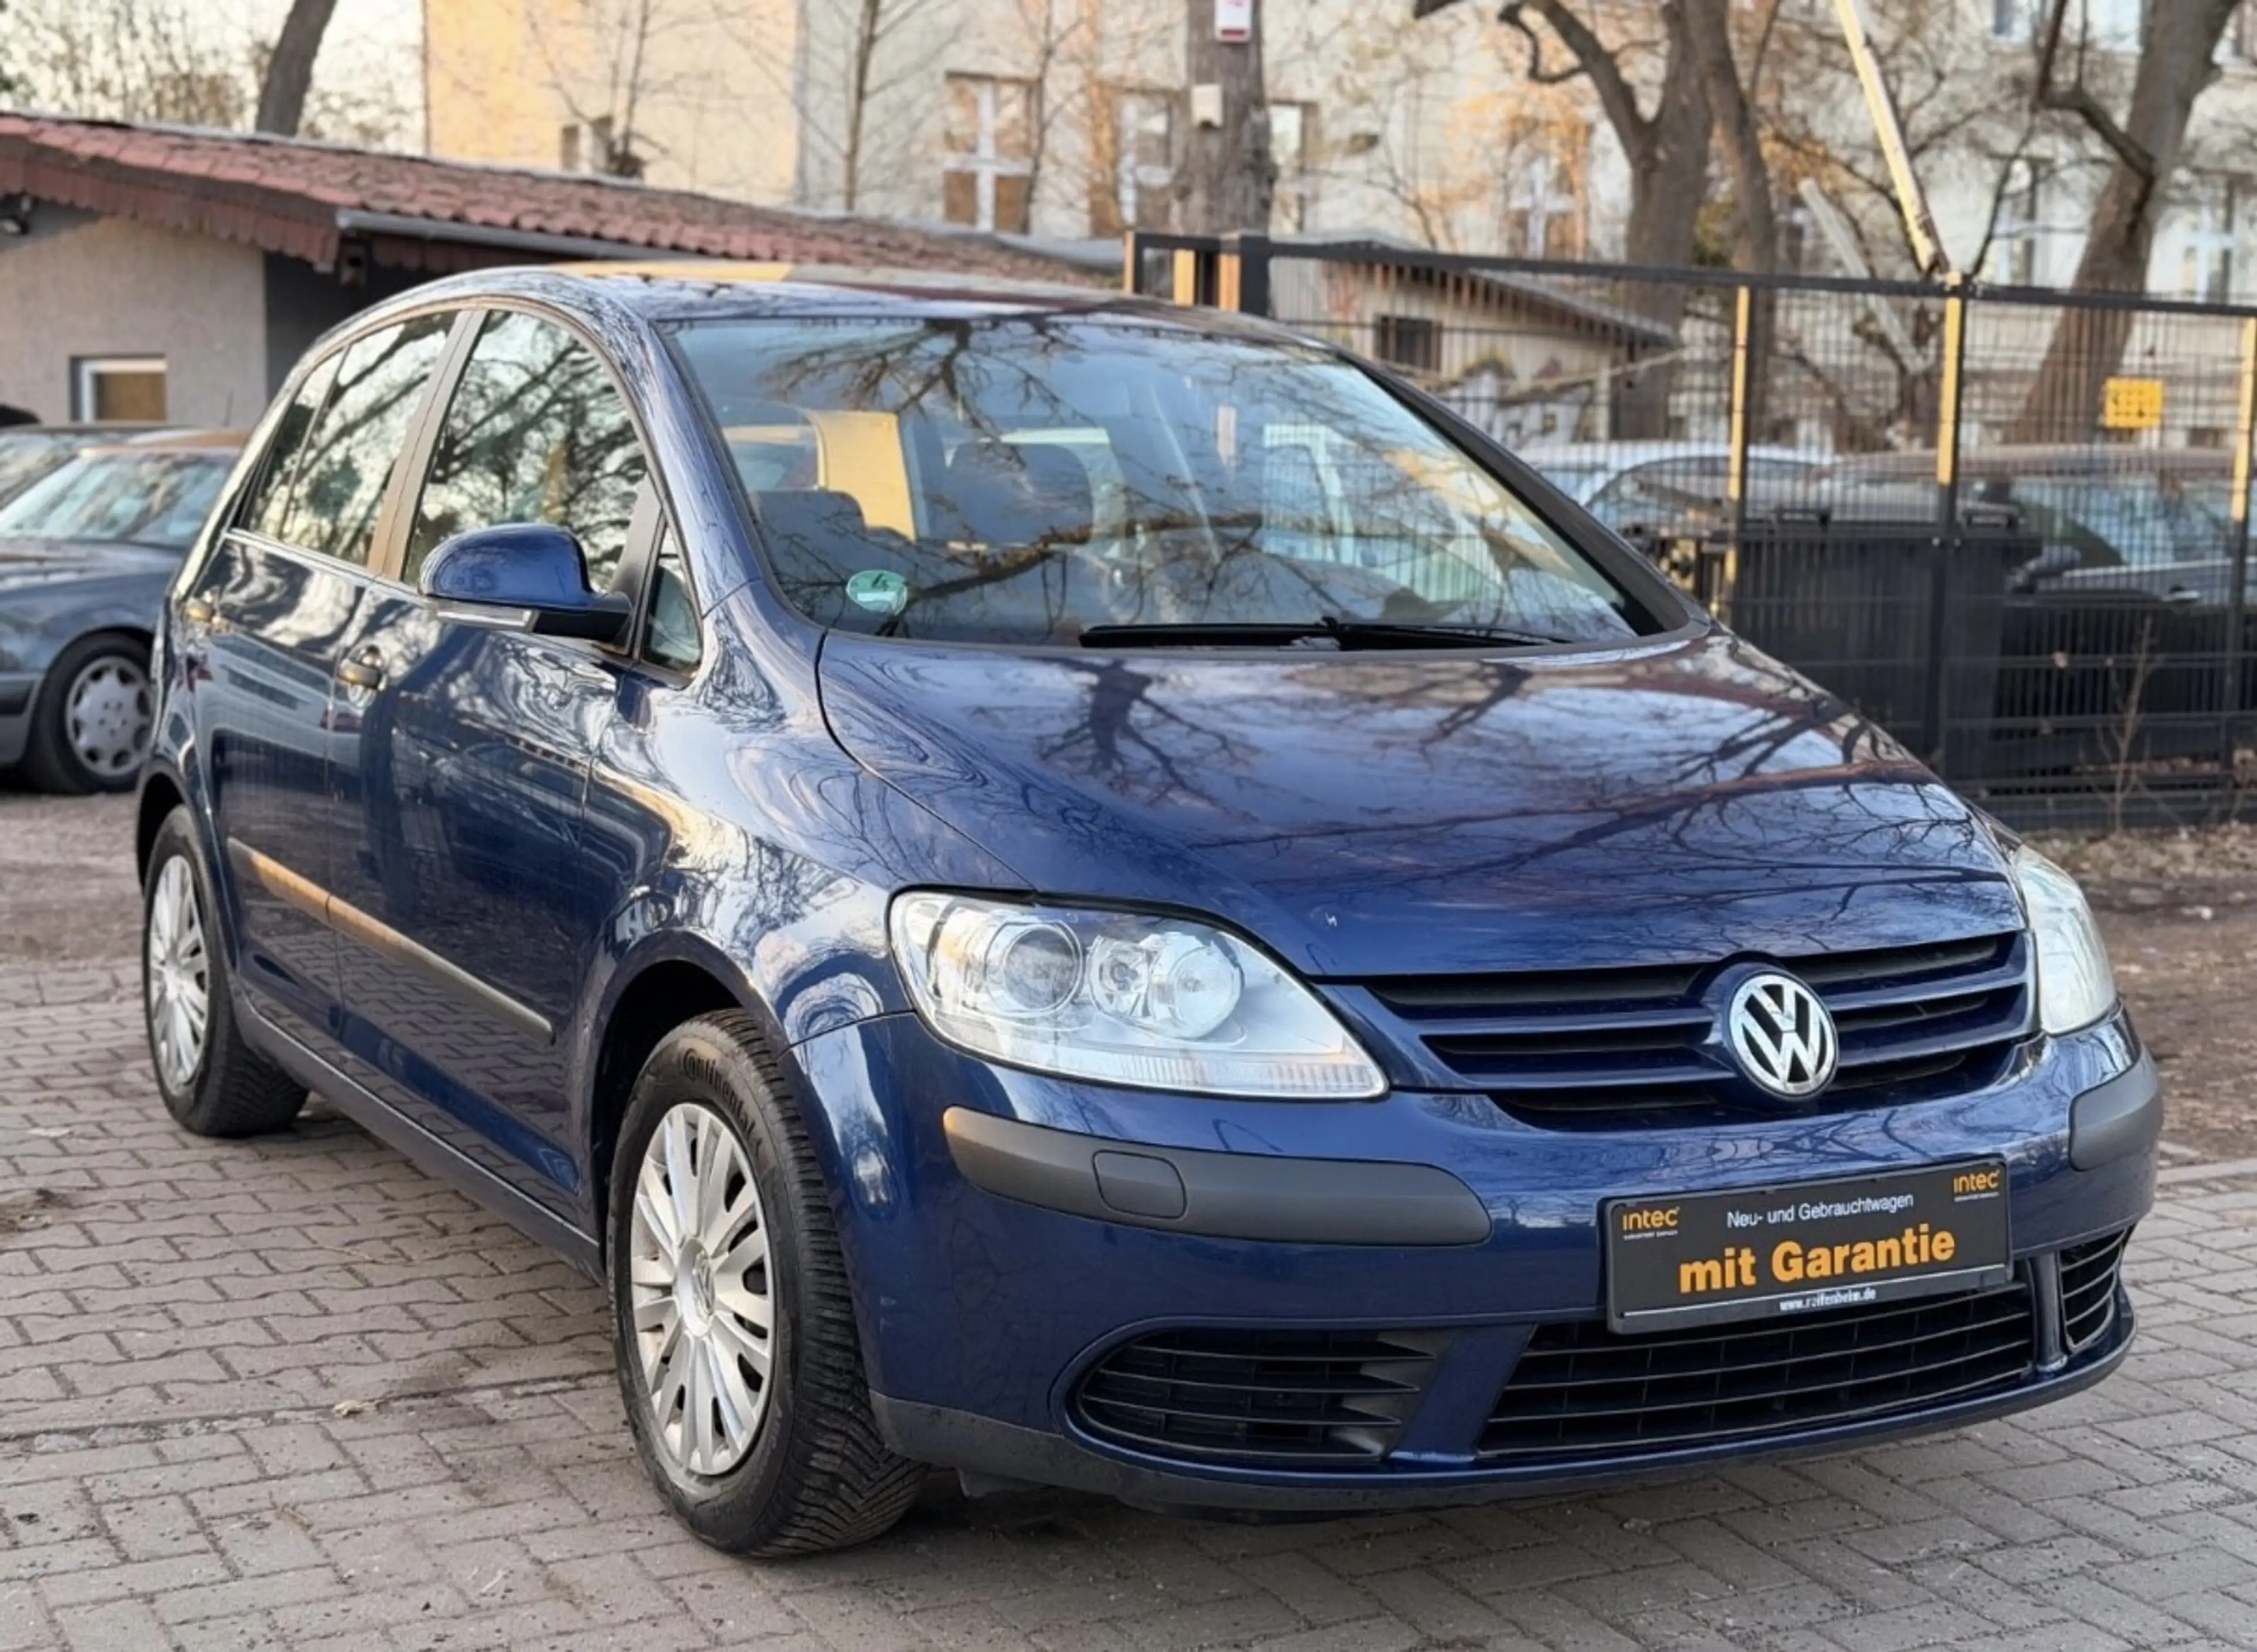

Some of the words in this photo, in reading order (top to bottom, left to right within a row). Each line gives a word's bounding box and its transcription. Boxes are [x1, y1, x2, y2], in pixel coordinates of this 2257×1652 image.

[1953, 1171, 1999, 1194] intec
[1623, 1208, 1679, 1231] intec
[1726, 1211, 1763, 1229] Neu-
[1767, 1205, 1794, 1224] und
[1798, 1193, 1914, 1221] Gebrauchtwagen
[1679, 1246, 1757, 1294] mit
[1772, 1223, 1955, 1283] Garantie
